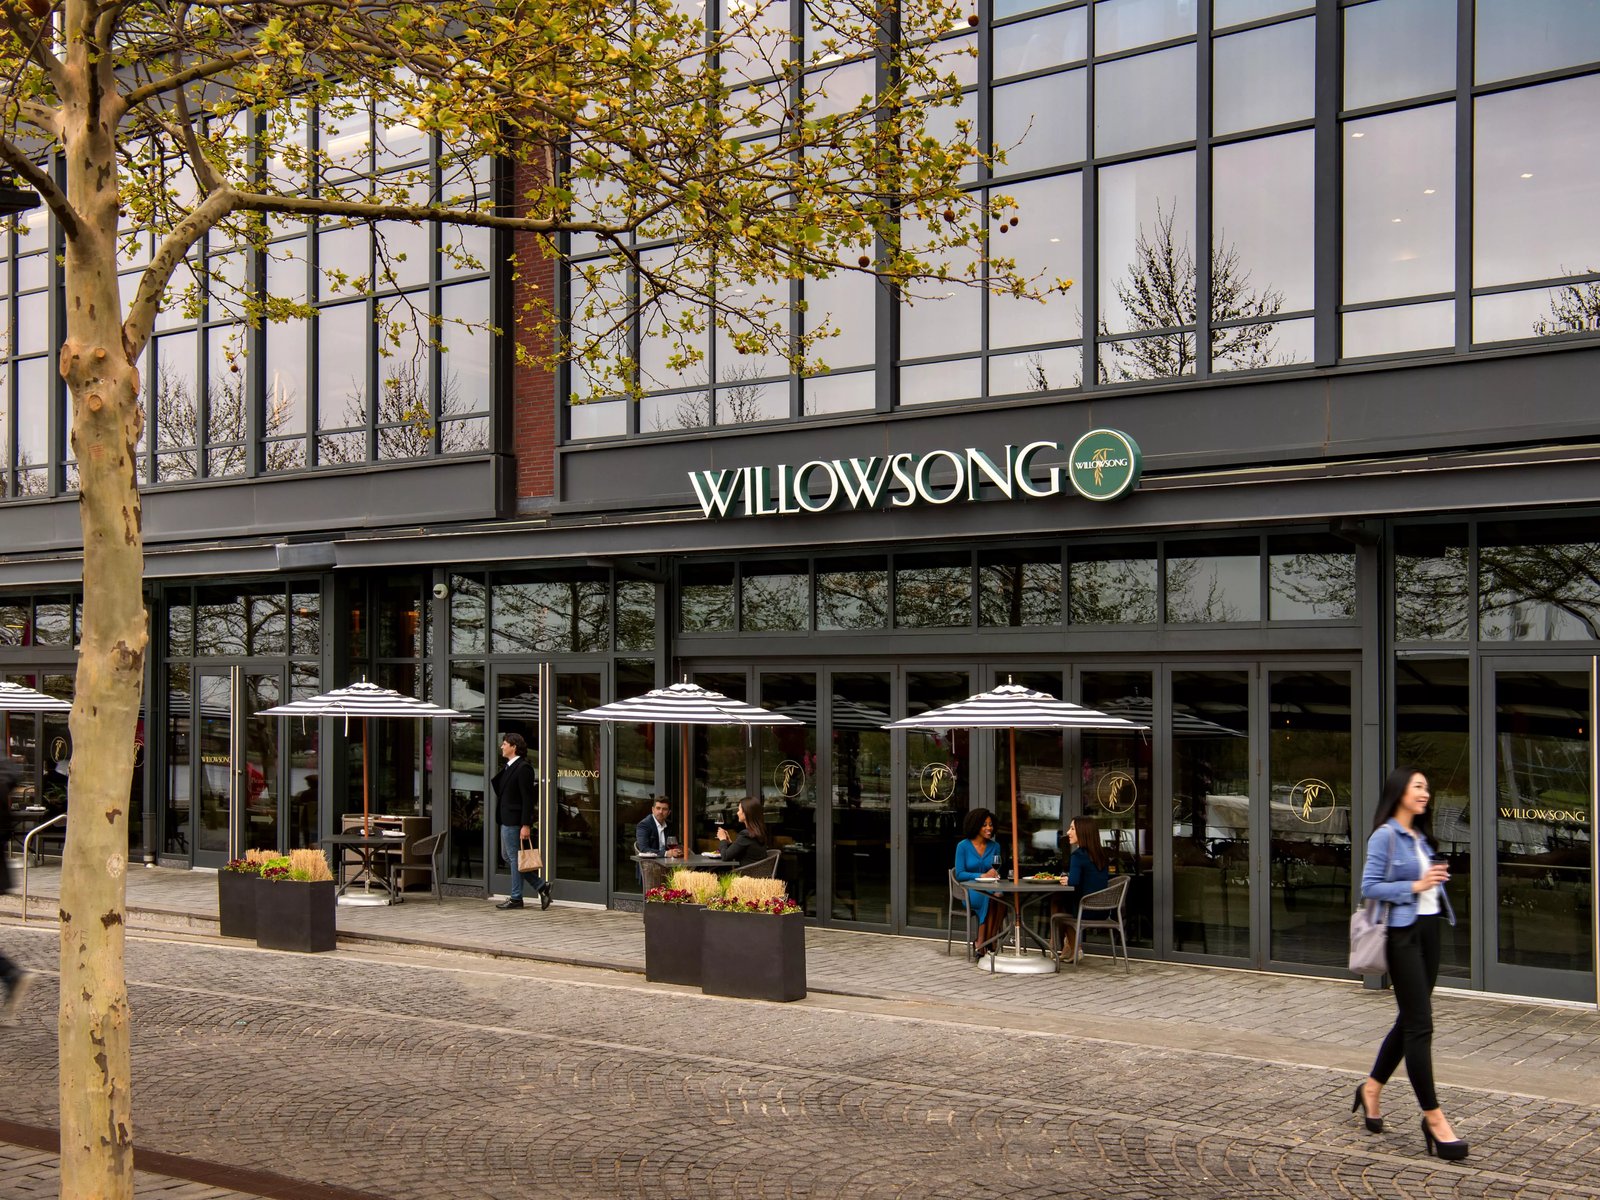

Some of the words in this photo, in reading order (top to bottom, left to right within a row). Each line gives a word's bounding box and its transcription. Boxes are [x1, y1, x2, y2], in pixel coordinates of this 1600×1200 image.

[1075, 458, 1128, 470] WILLOWSONG
[687, 441, 1064, 518] WILLOWSONG
[1500, 807, 1585, 822] WILLOWSONG
